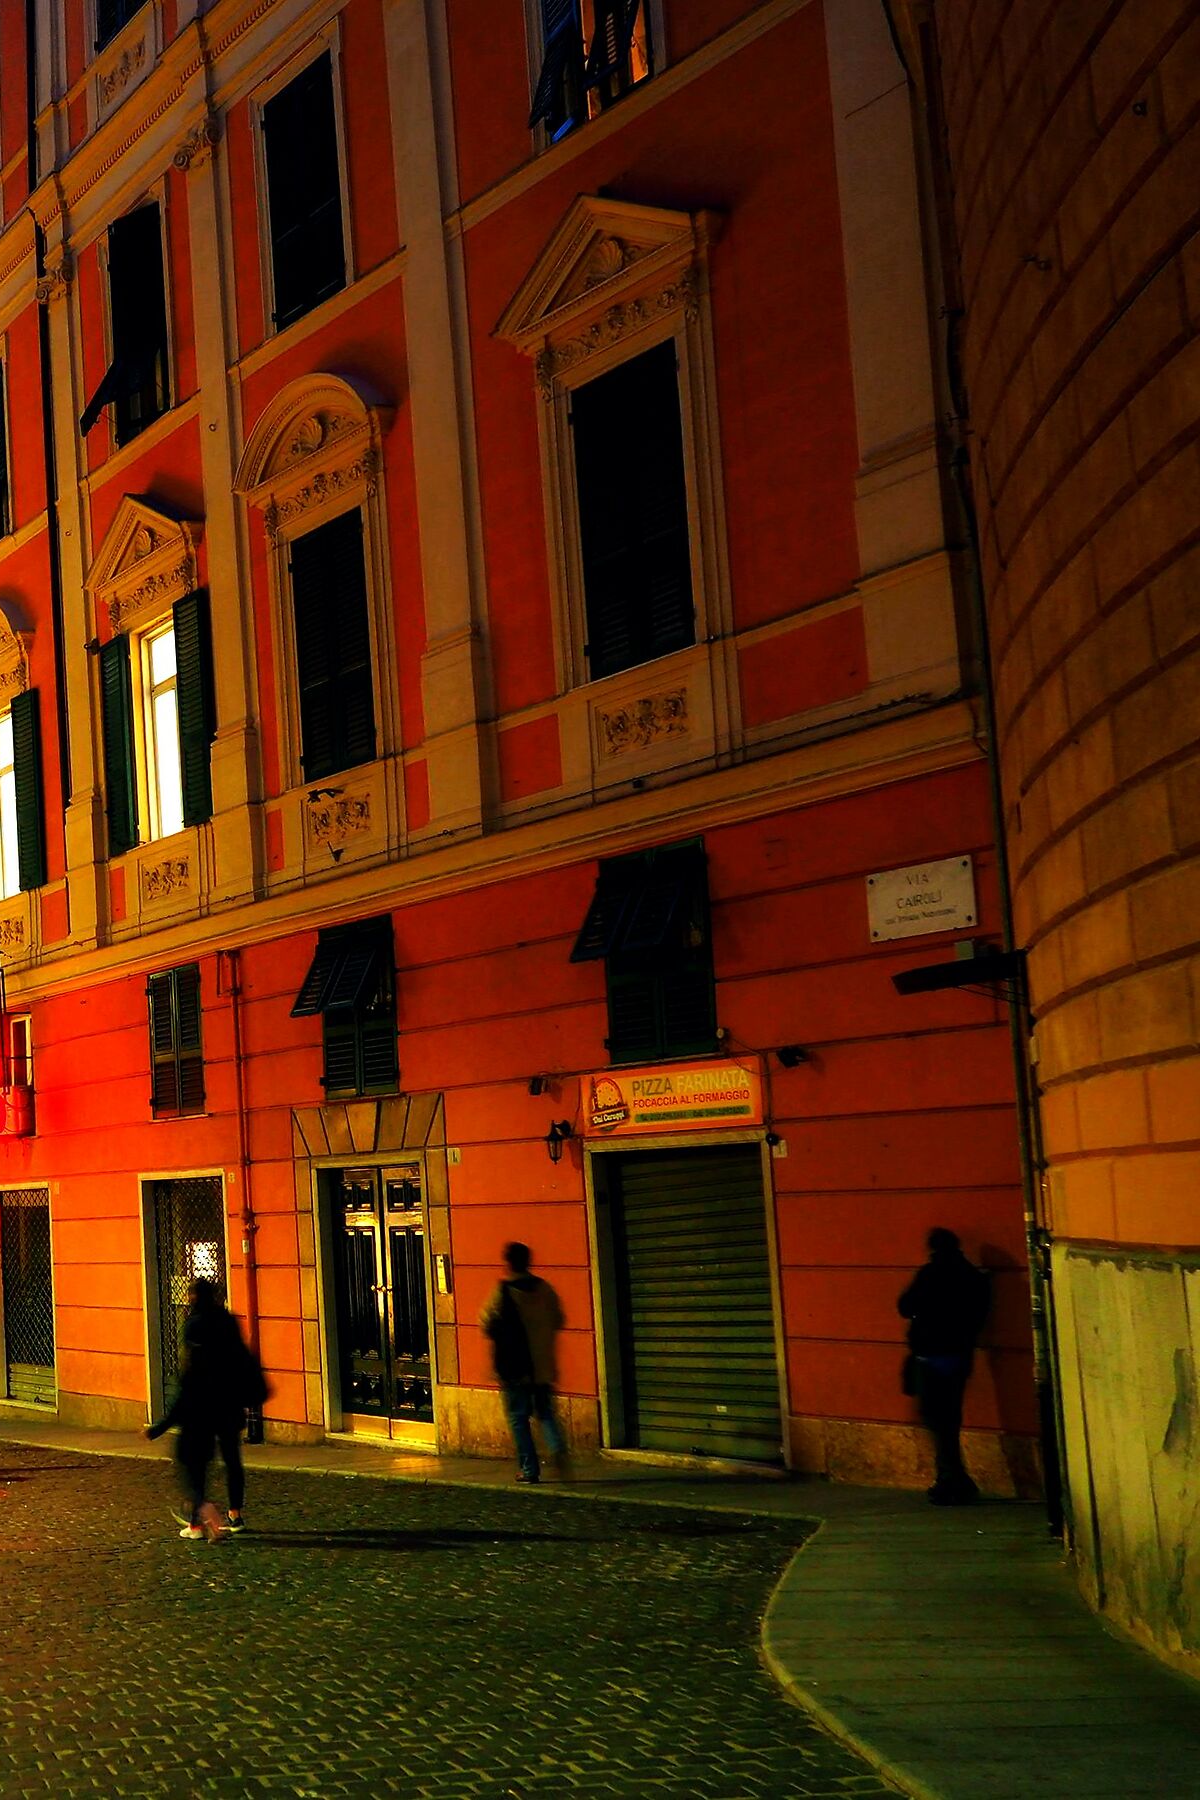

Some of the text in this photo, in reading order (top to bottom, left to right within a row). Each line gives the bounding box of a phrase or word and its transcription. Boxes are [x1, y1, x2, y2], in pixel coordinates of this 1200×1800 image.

[632, 1069, 750, 1097] PIZZA FARINATA
[633, 1089, 750, 1108] FOCACCIA AL FORMAGGIO
